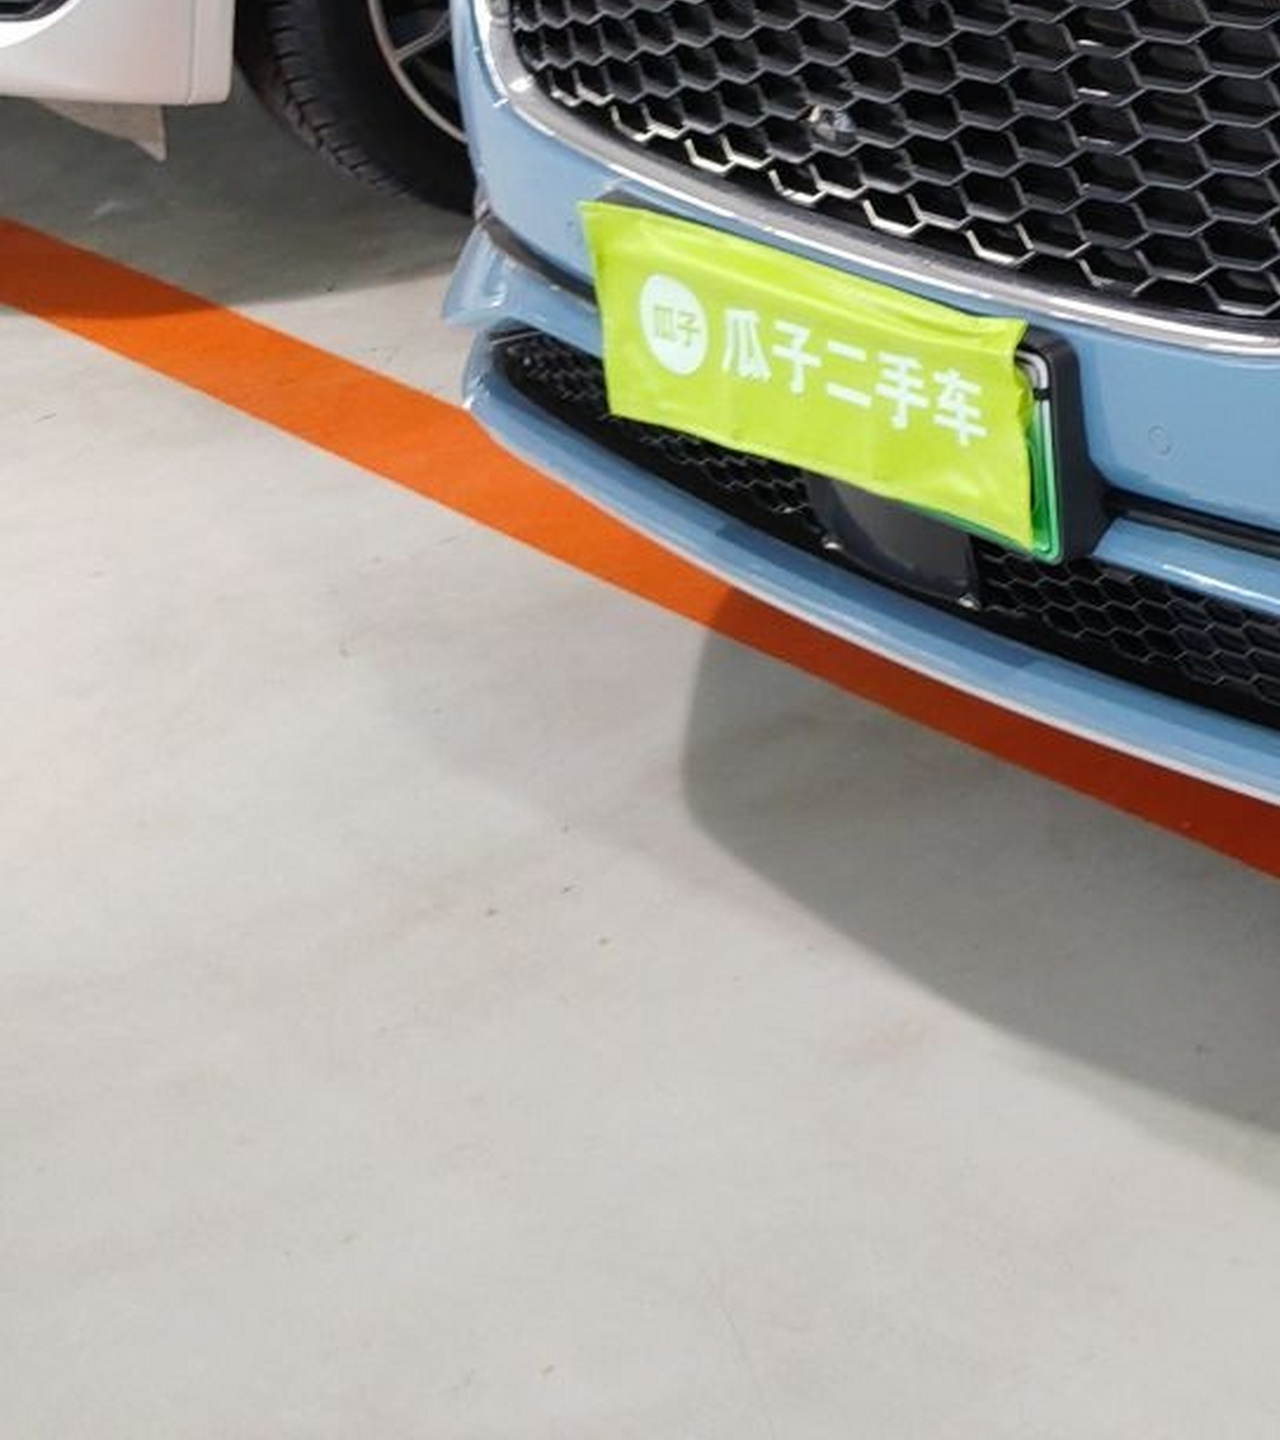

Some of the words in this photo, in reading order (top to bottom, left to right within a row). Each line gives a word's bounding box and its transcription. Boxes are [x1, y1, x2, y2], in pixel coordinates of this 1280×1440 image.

[652, 304, 699, 348] 瓜子
[721, 307, 988, 448] 瓜子二手车
